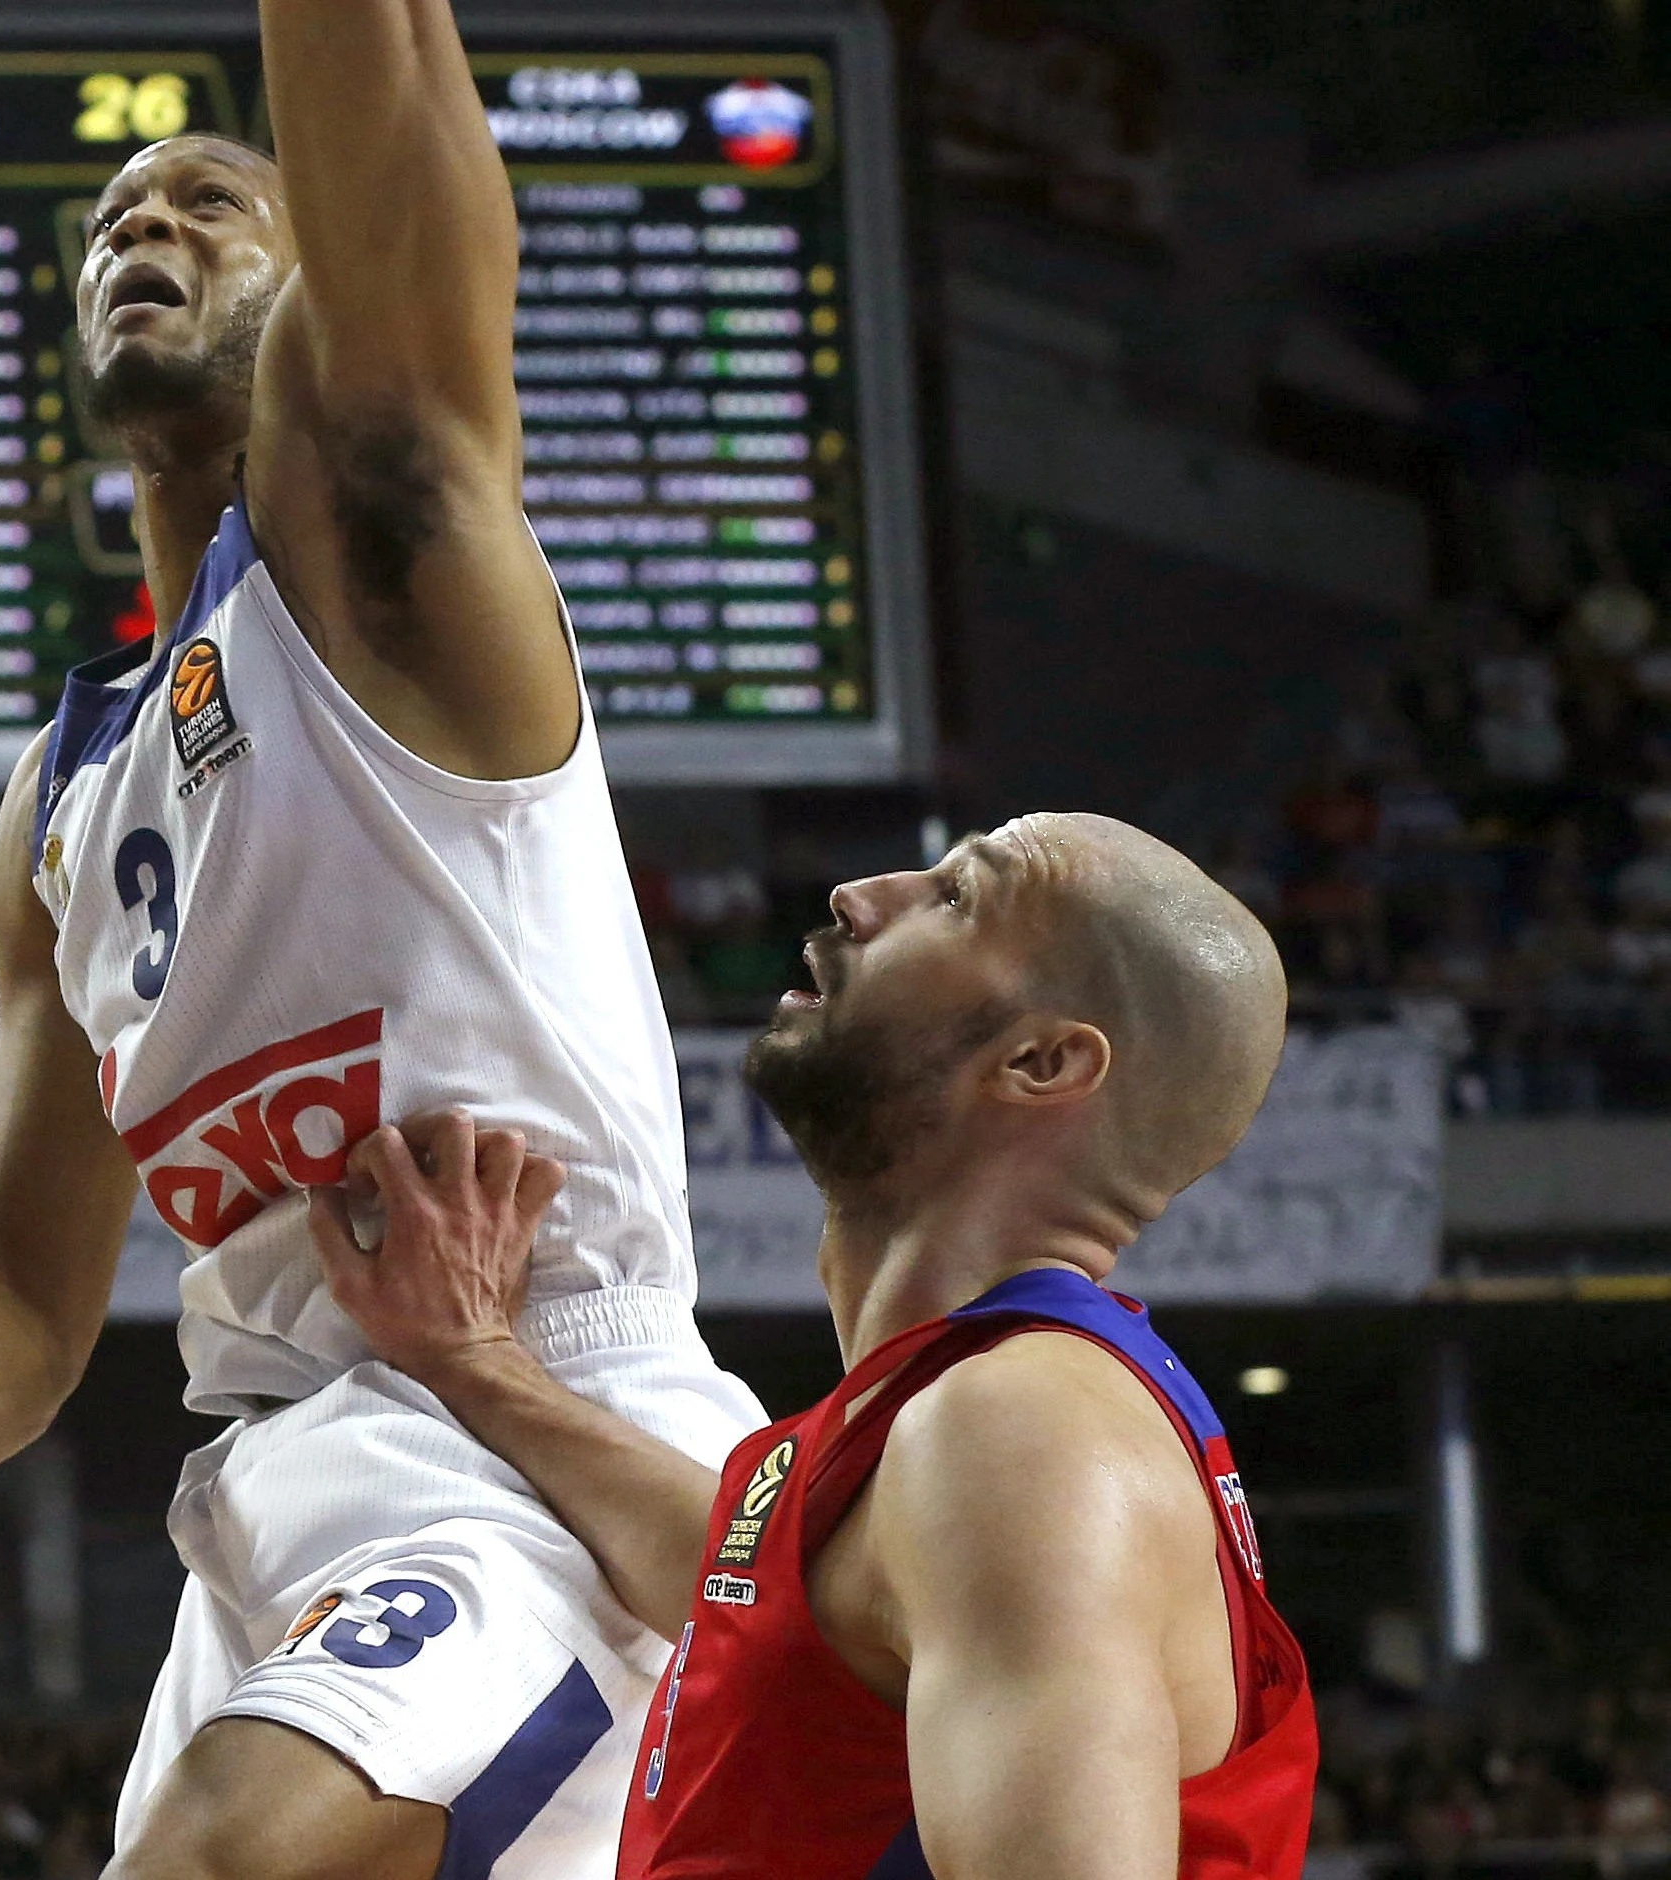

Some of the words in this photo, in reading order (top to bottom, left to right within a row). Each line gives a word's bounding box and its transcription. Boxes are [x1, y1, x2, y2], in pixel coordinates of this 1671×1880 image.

[73, 72, 188, 143] 26
[508, 66, 641, 104] CSKA
[178, 698, 221, 737] TURKISH
[181, 710, 224, 750] AIRLINES
[114, 827, 179, 1001] 3
[320, 1579, 457, 1669] 3
